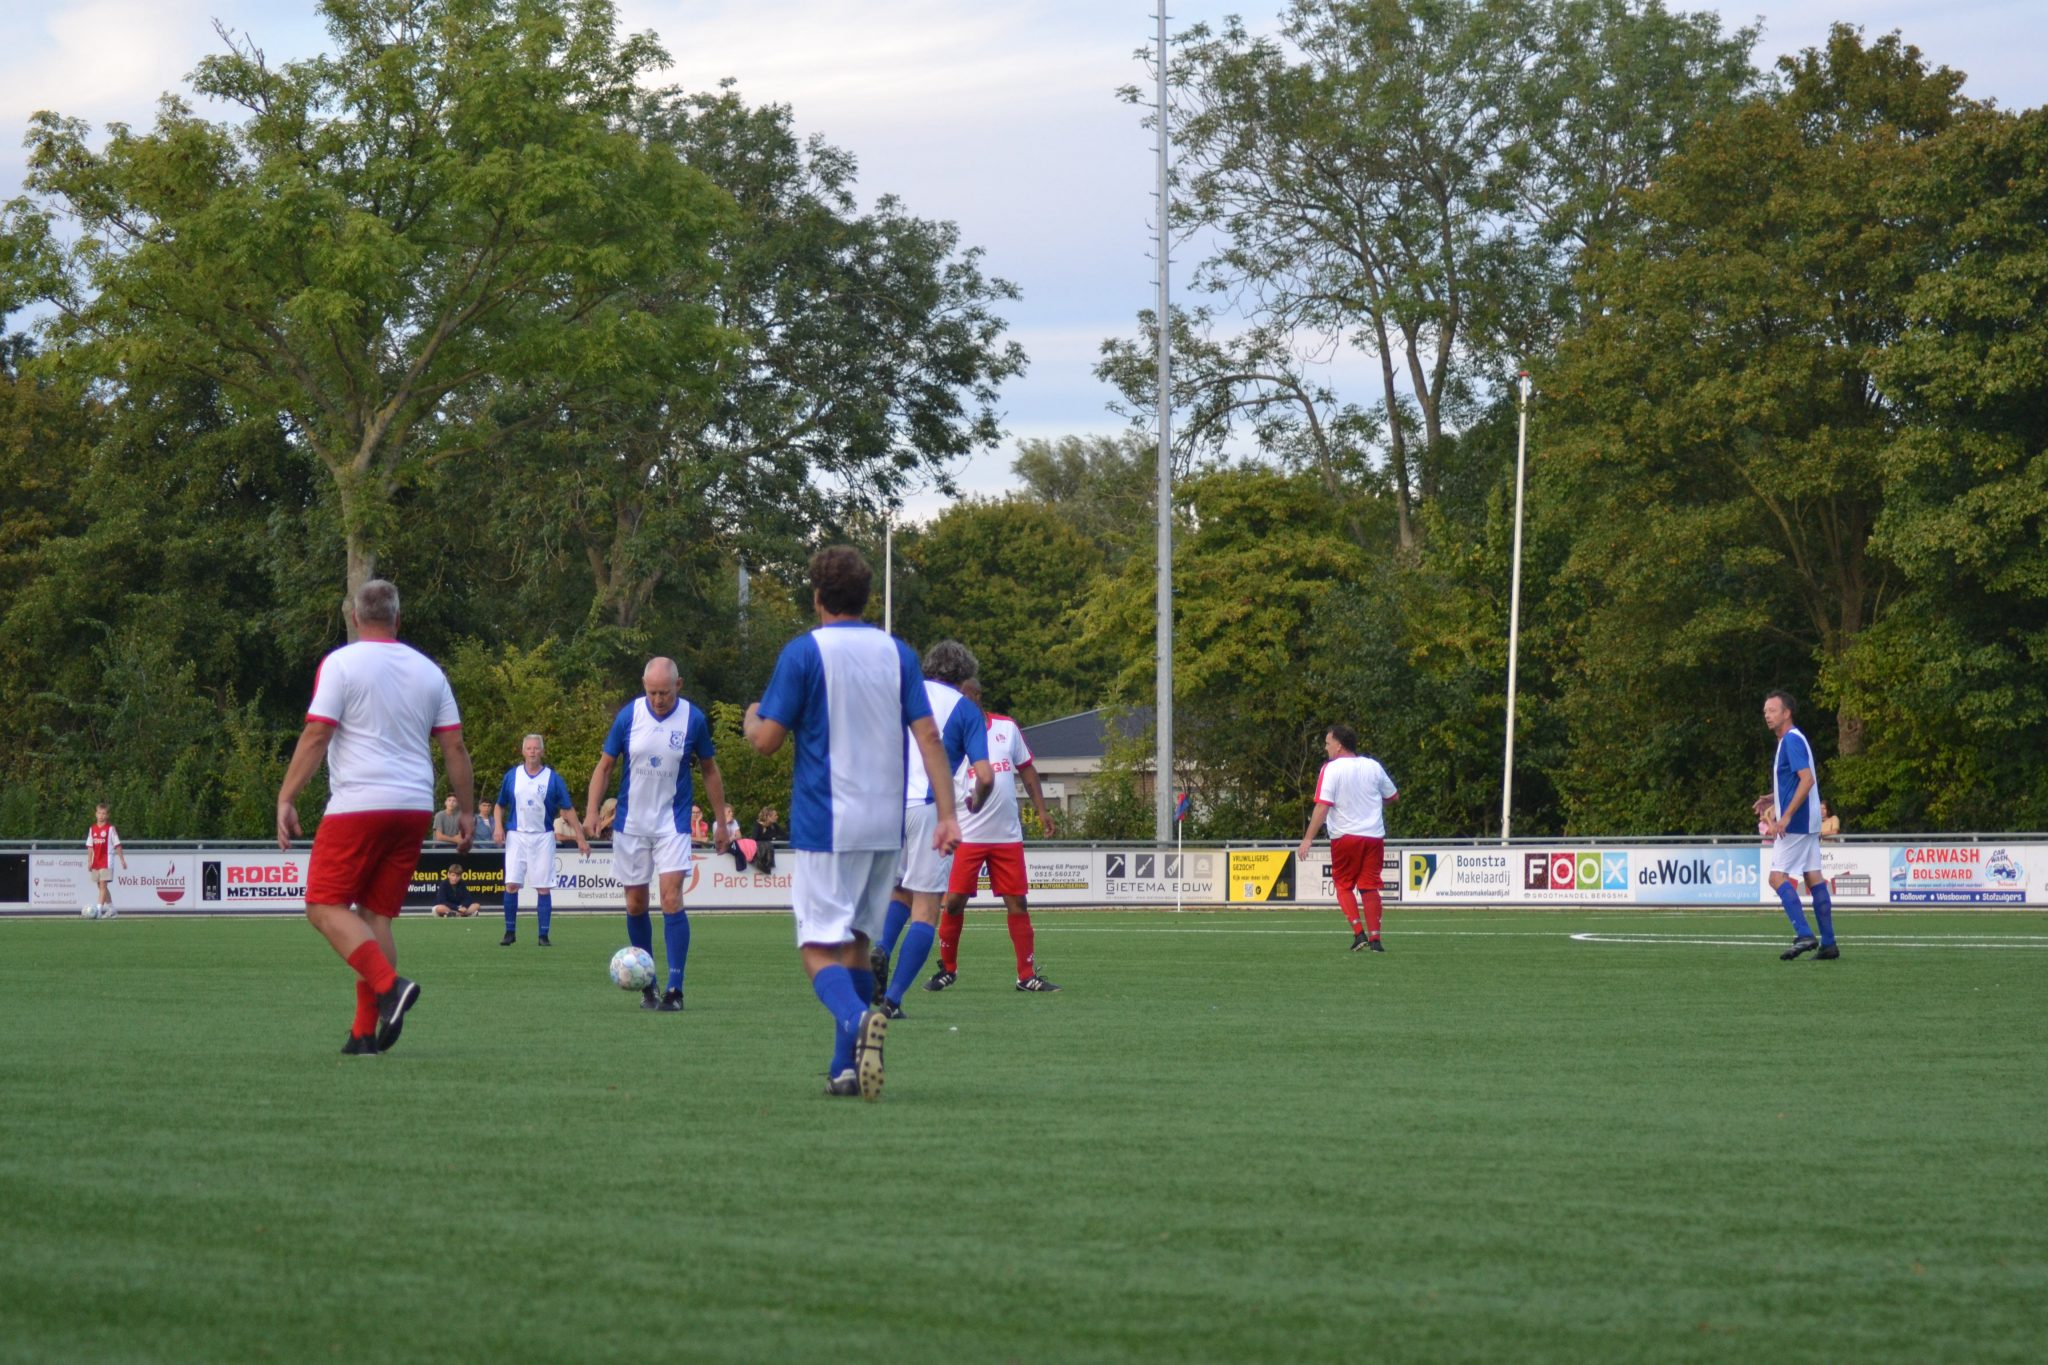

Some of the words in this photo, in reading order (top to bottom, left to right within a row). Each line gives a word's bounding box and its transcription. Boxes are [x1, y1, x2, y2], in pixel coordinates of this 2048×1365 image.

[1457, 855, 1506, 867] Boonstra
[1905, 848, 1980, 864] CARWASH
[411, 870, 439, 881] teun
[461, 869, 504, 881] olsward
[1528, 858, 1627, 885] FOOX
[1913, 868, 1973, 880] BOLSWARD
[118, 876, 138, 886] Wok
[141, 876, 185, 886] Bolsward
[713, 873, 748, 888] Parc
[753, 873, 793, 888] Estat
[1457, 870, 1511, 886] Makelaardij
[227, 887, 306, 897] METSELWE
[481, 885, 493, 894] per
[494, 884, 507, 894] jaa
[1106, 882, 1166, 892] GIETEMA
[578, 891, 609, 899] Roestvast
[1436, 889, 1510, 897] www.boonstramakelaardij.nl
[1900, 892, 1927, 901] Rollover
[1936, 892, 1971, 901] Wasboxen
[1982, 892, 2022, 903] Stofzuigers
